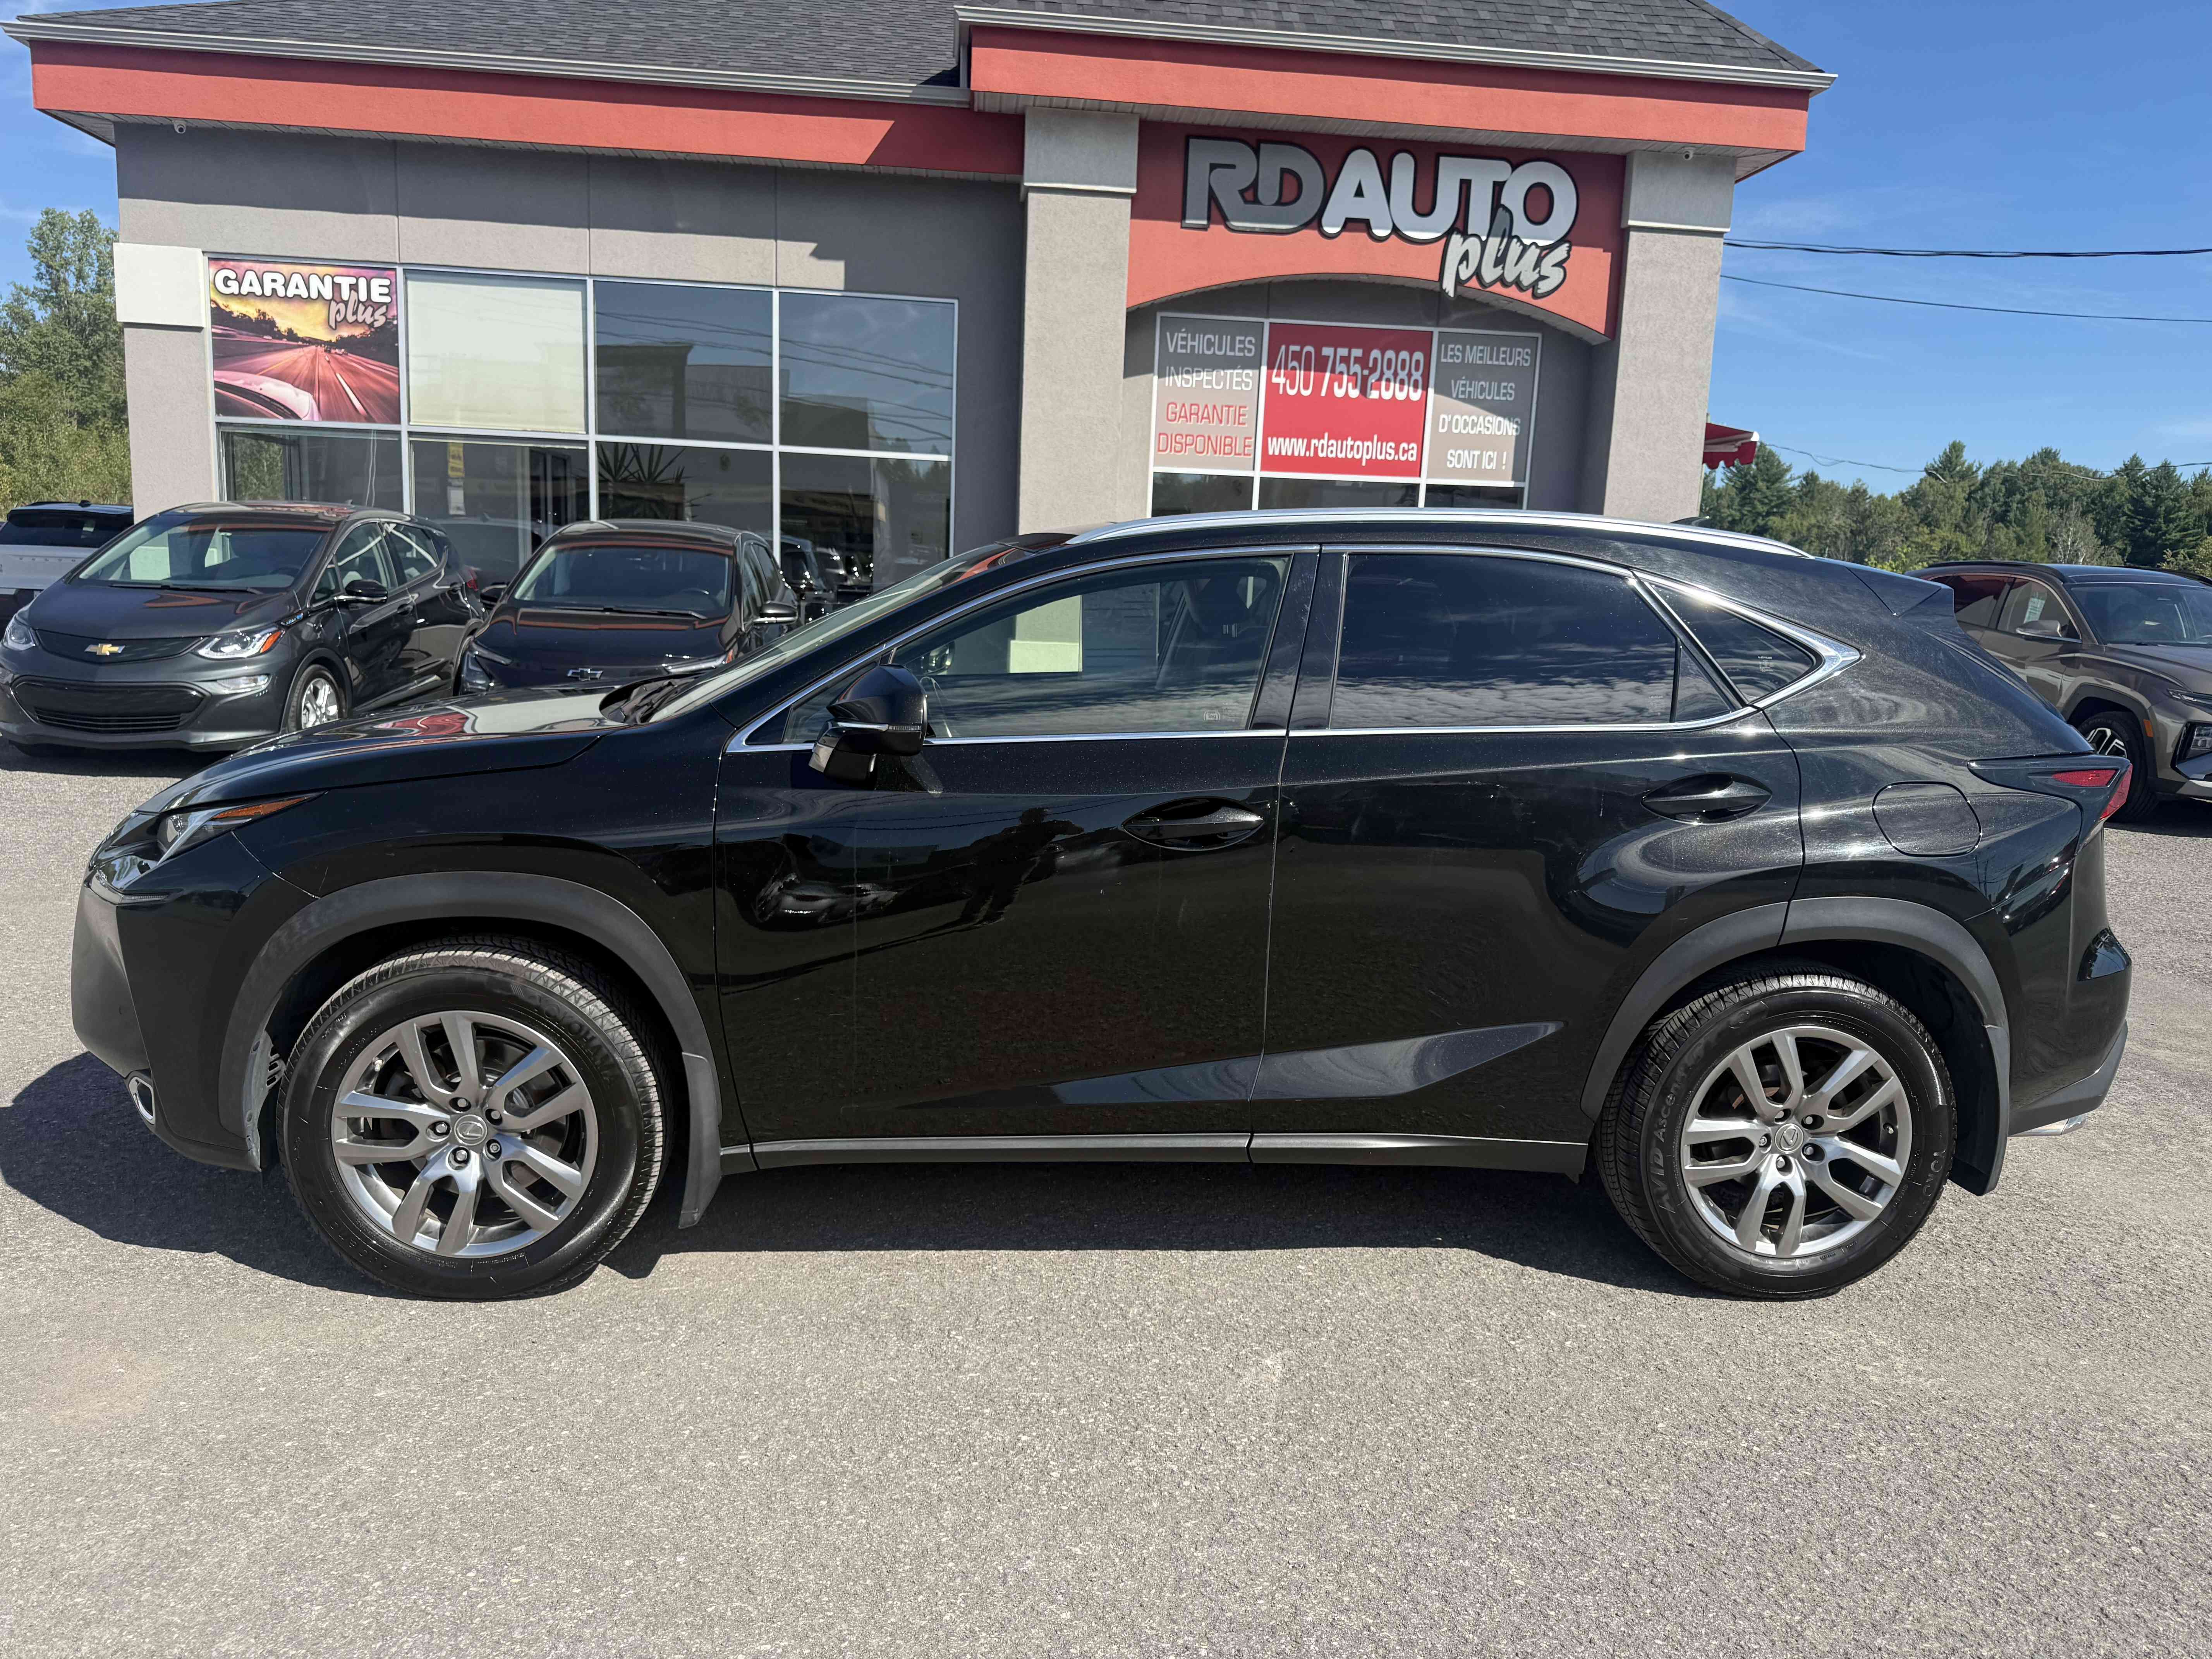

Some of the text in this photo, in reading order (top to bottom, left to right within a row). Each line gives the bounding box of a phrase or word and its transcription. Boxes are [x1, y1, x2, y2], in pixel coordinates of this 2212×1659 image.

[1441, 205, 1571, 299] plus
[215, 269, 392, 303] GARANTIE
[328, 289, 387, 329] plus
[1166, 328, 1255, 357] VÉHICULES
[1441, 344, 1531, 366] LES MEILLEURS
[1165, 366, 1252, 391] INSPECTÉS
[1271, 345, 1424, 401] 450 755-2888
[1451, 376, 1515, 400] VÉHICULES
[1166, 402, 1249, 426] GARANTIE
[1438, 414, 1521, 436] D'OCCASIONS
[1158, 433, 1253, 457] DISPONIBLE
[1267, 432, 1417, 466] www.rdautoplus.ca
[1446, 449, 1507, 470] SONT ICI !
